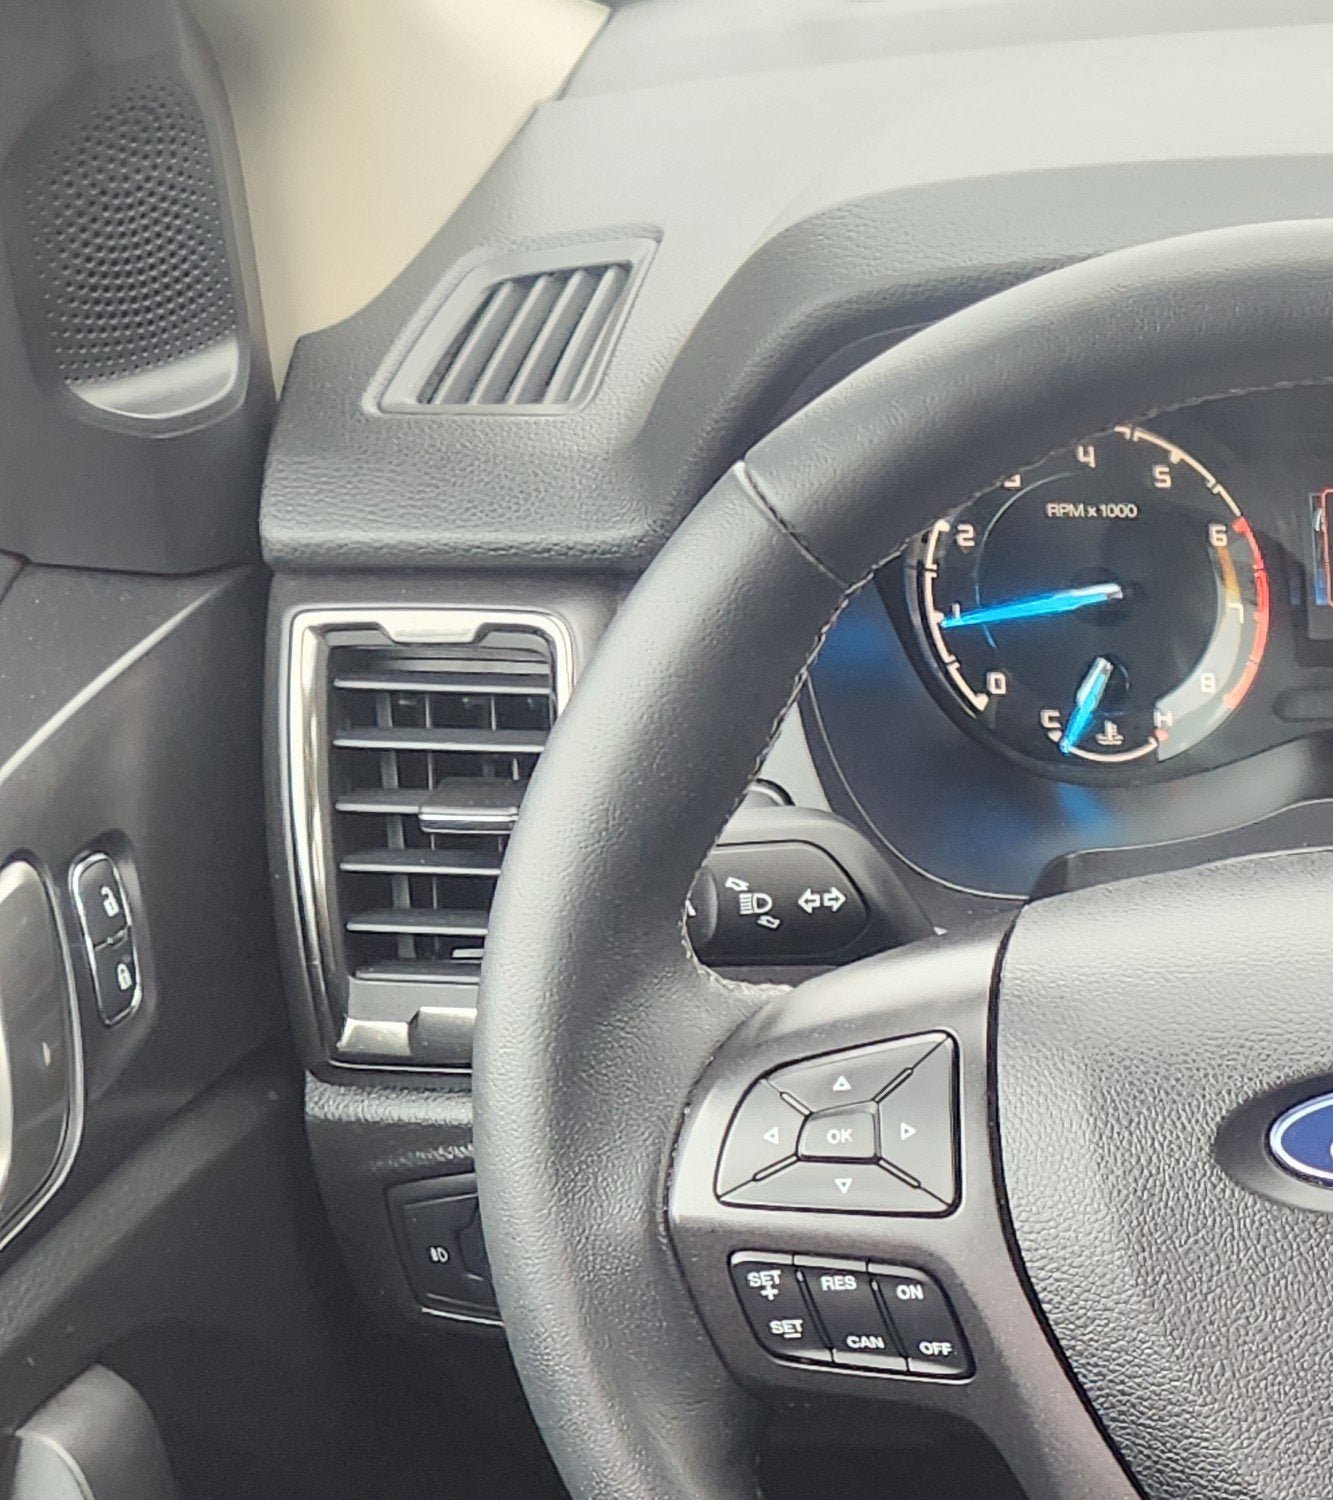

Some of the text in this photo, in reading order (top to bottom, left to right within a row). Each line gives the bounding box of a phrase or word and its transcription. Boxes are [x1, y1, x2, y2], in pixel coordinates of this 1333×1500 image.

[1077, 446, 1096, 469] 4
[1153, 465, 1171, 488] 5
[1046, 503, 1138, 518] RPM x 1000
[956, 524, 975, 547] 2
[1209, 523, 1228, 547] 6
[987, 672, 1005, 694] 0
[1040, 709, 1061, 730] C
[1154, 709, 1173, 728] H
[826, 1127, 853, 1145] OK
[747, 1269, 783, 1287] SET
[820, 1274, 858, 1292] RES
[895, 1284, 924, 1301] ON
[769, 1318, 804, 1334] SET
[845, 1333, 886, 1350] CAN
[918, 1339, 954, 1357] OFF
